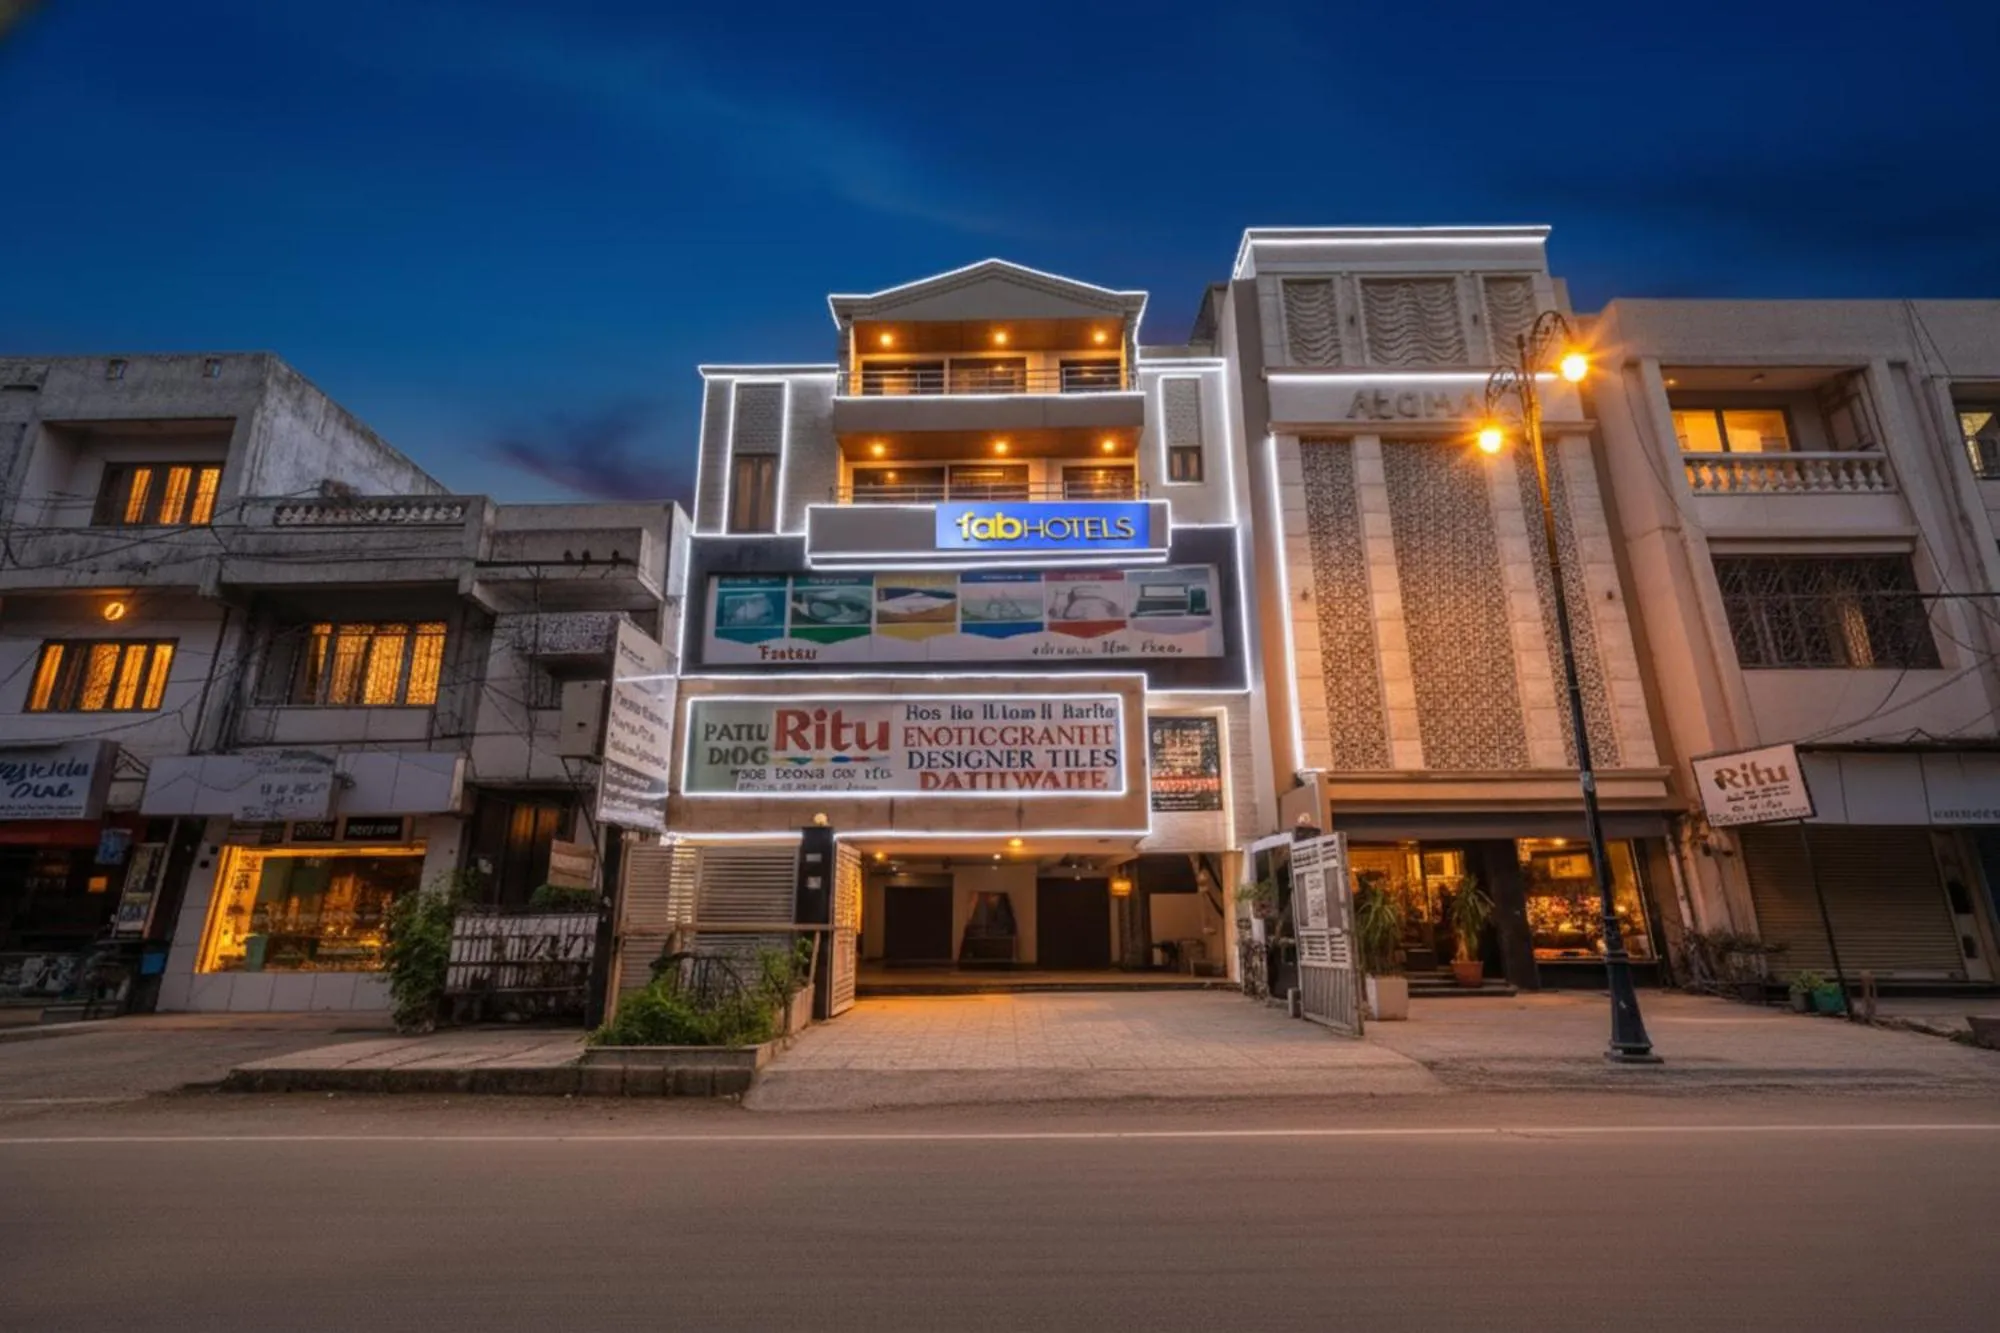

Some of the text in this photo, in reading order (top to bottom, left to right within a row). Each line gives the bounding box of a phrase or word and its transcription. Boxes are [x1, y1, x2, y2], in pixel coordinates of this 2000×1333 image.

[774, 708, 890, 752] Ritu
[907, 749, 1118, 769] DESIGNER TILES
